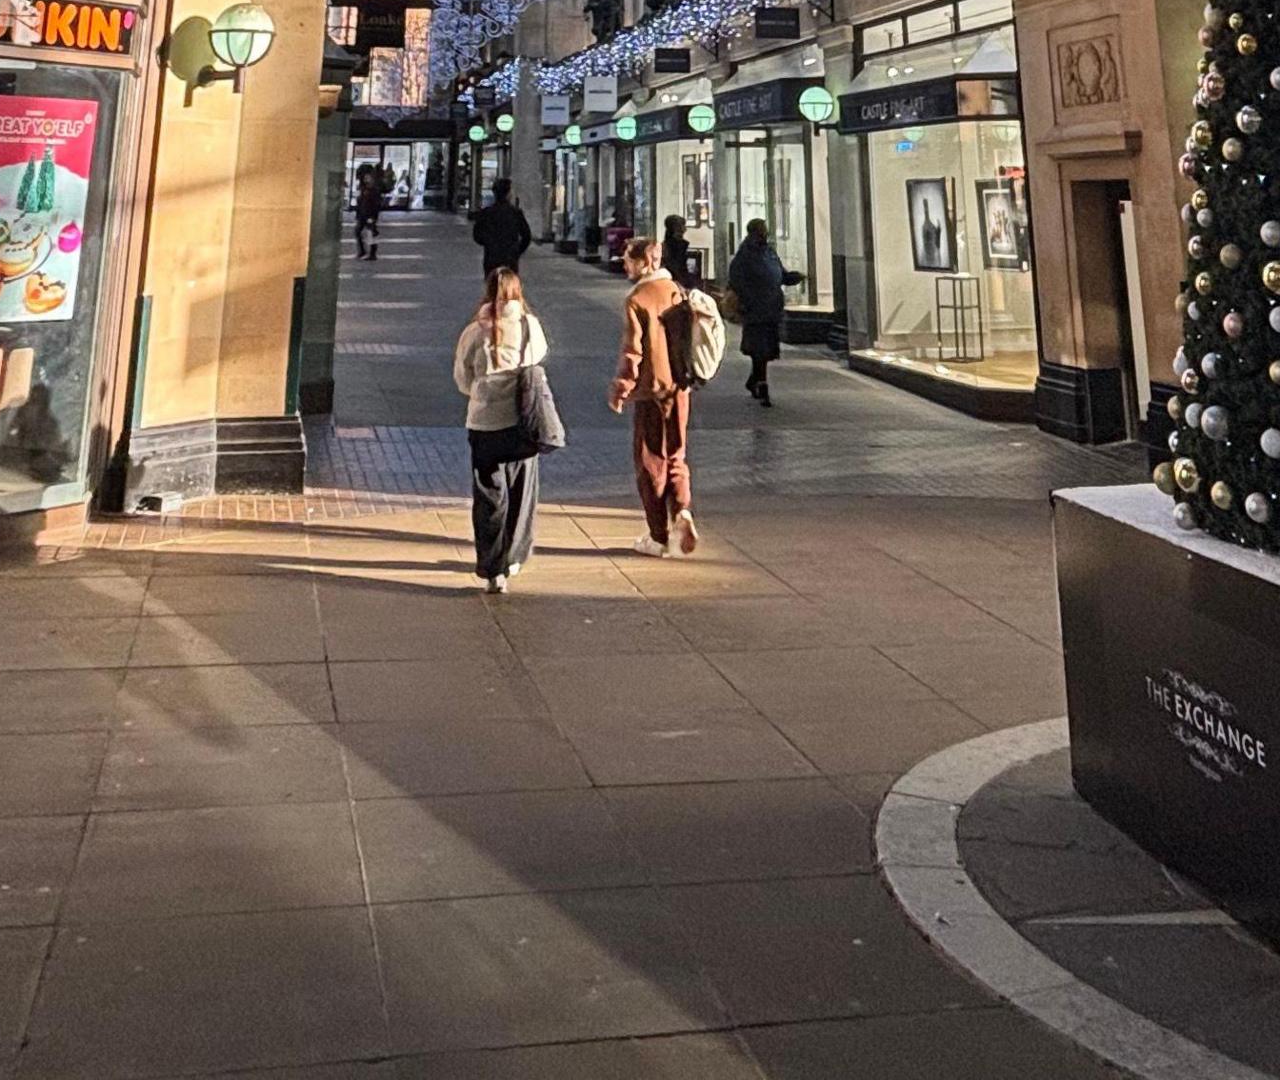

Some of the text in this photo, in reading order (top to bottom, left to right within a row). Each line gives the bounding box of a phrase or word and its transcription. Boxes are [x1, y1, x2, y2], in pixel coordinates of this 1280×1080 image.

[861, 101, 889, 120] CASTLE
[1145, 675, 1172, 713] THE
[1175, 693, 1267, 768] EXCHANGE
